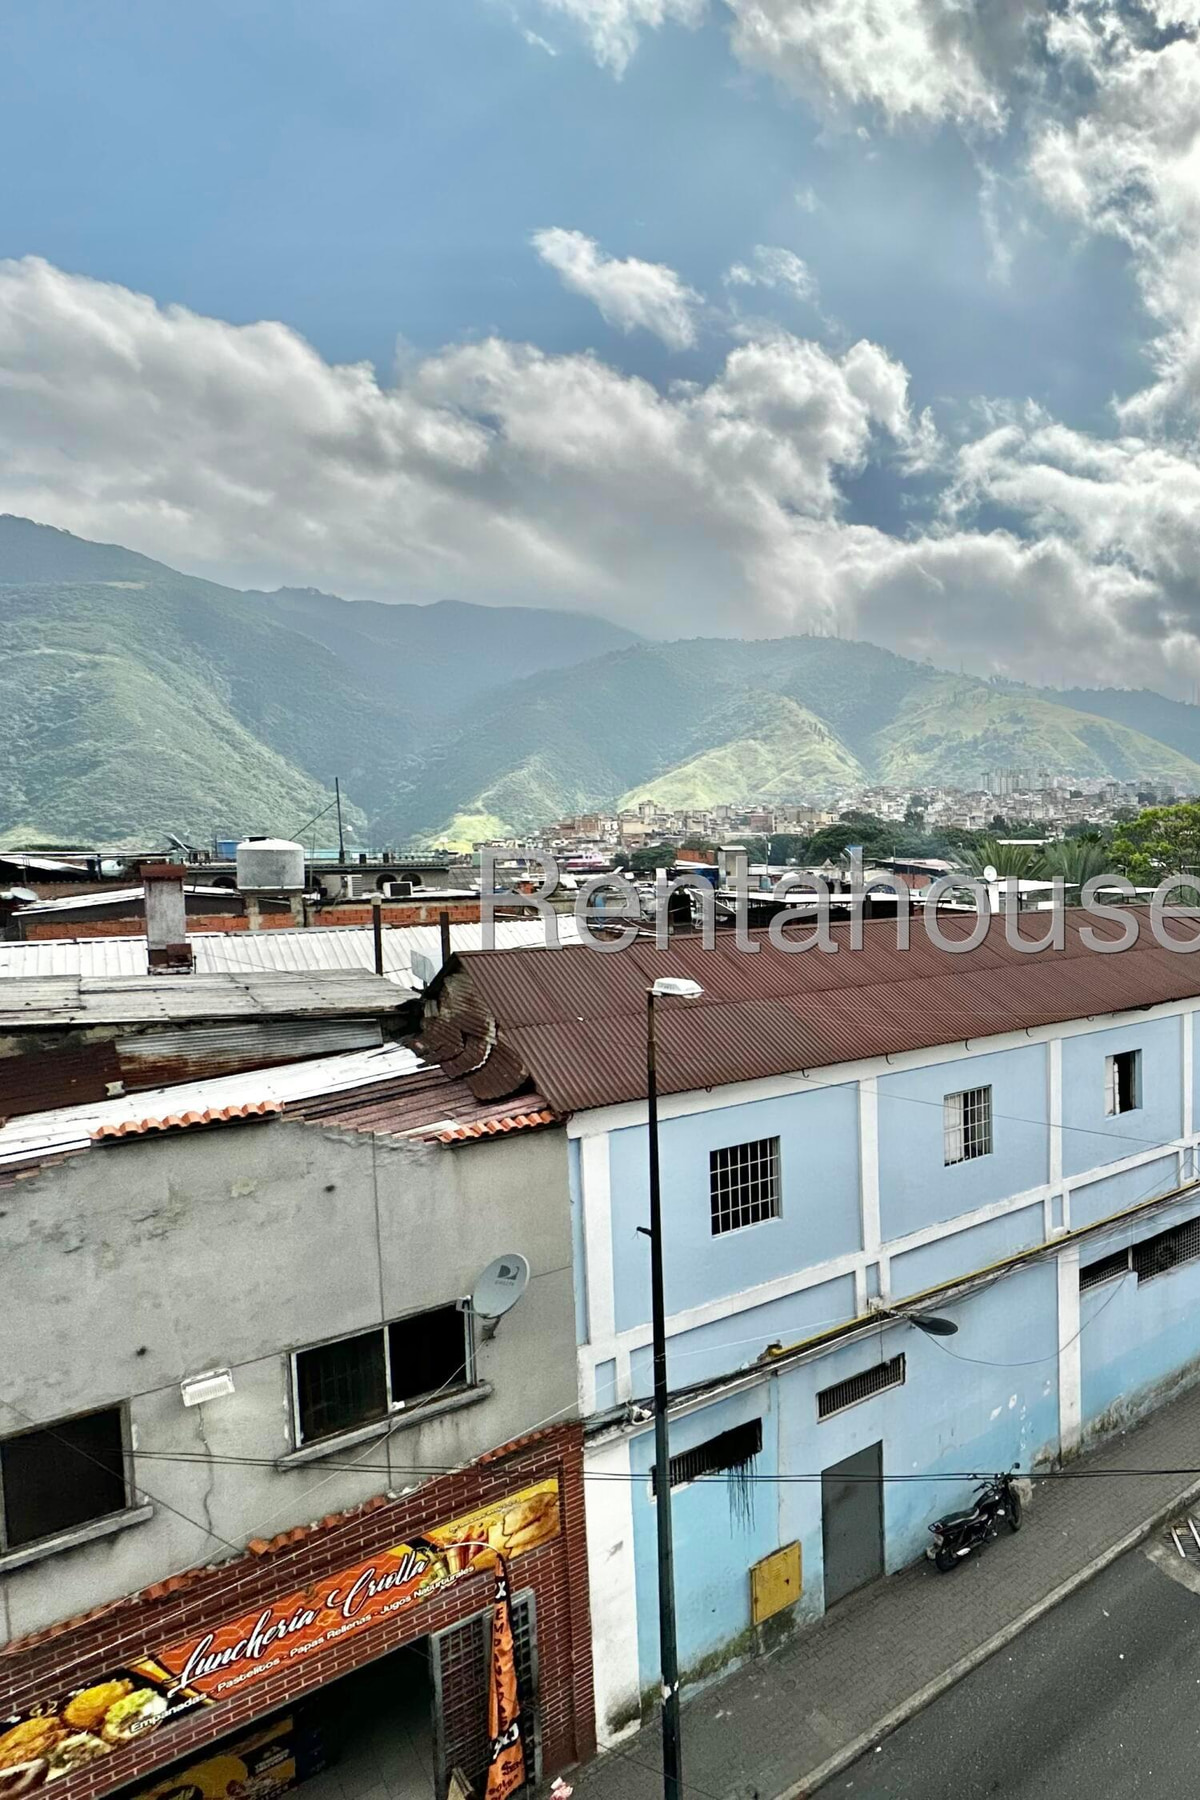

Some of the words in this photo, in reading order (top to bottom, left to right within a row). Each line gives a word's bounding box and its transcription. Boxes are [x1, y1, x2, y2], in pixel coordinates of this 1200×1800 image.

[129, 1692, 208, 1733] Empanadas
[217, 1658, 281, 1693] Pastelitos
[289, 1637, 325, 1661] Papas
[327, 1614, 372, 1639] Rellenas
[380, 1595, 411, 1615] Jugos
[167, 1607, 319, 1698] Lunchería
[326, 1550, 429, 1618] Criolla
